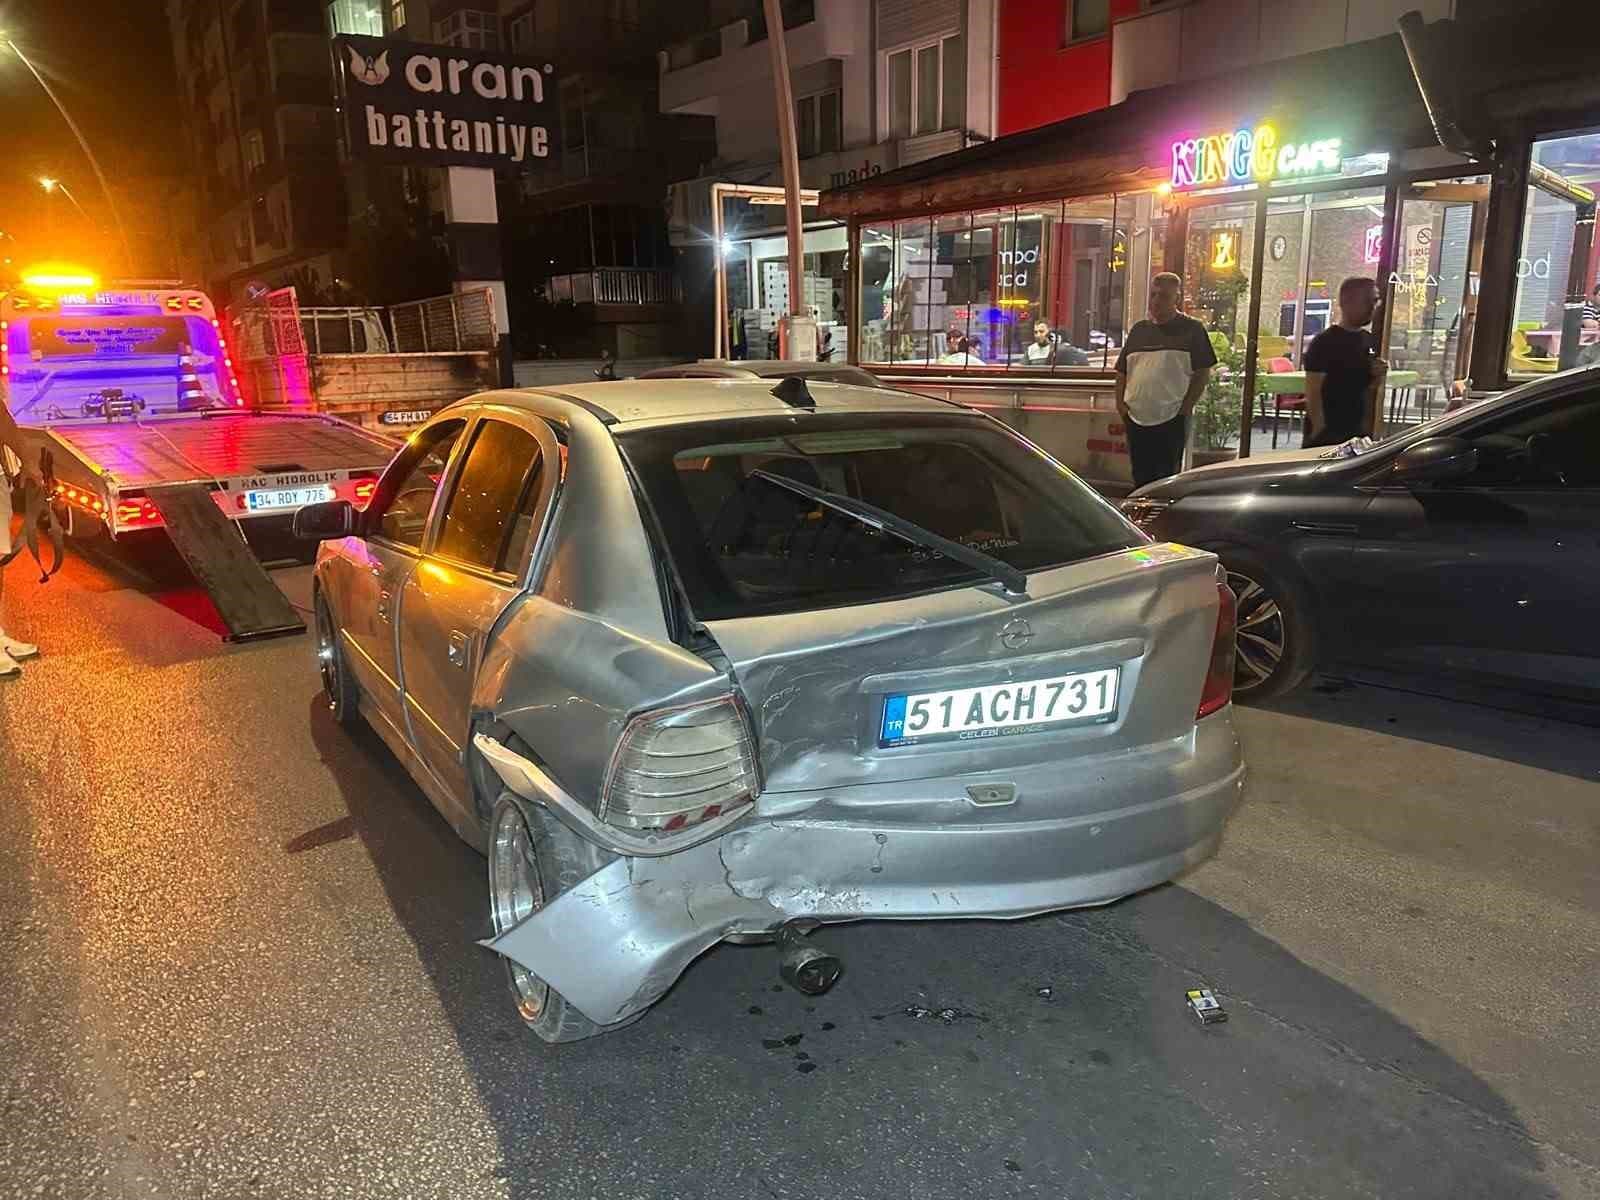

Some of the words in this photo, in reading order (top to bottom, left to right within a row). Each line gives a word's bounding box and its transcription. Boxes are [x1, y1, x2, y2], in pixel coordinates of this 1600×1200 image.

[365, 104, 549, 162] battaniye
[1277, 137, 1343, 175] CAFE
[257, 493, 271, 506] 34
[908, 695, 953, 732] 51
[964, 685, 1037, 726] ACH
[1044, 674, 1108, 718] 731
[887, 720, 903, 730] TR
